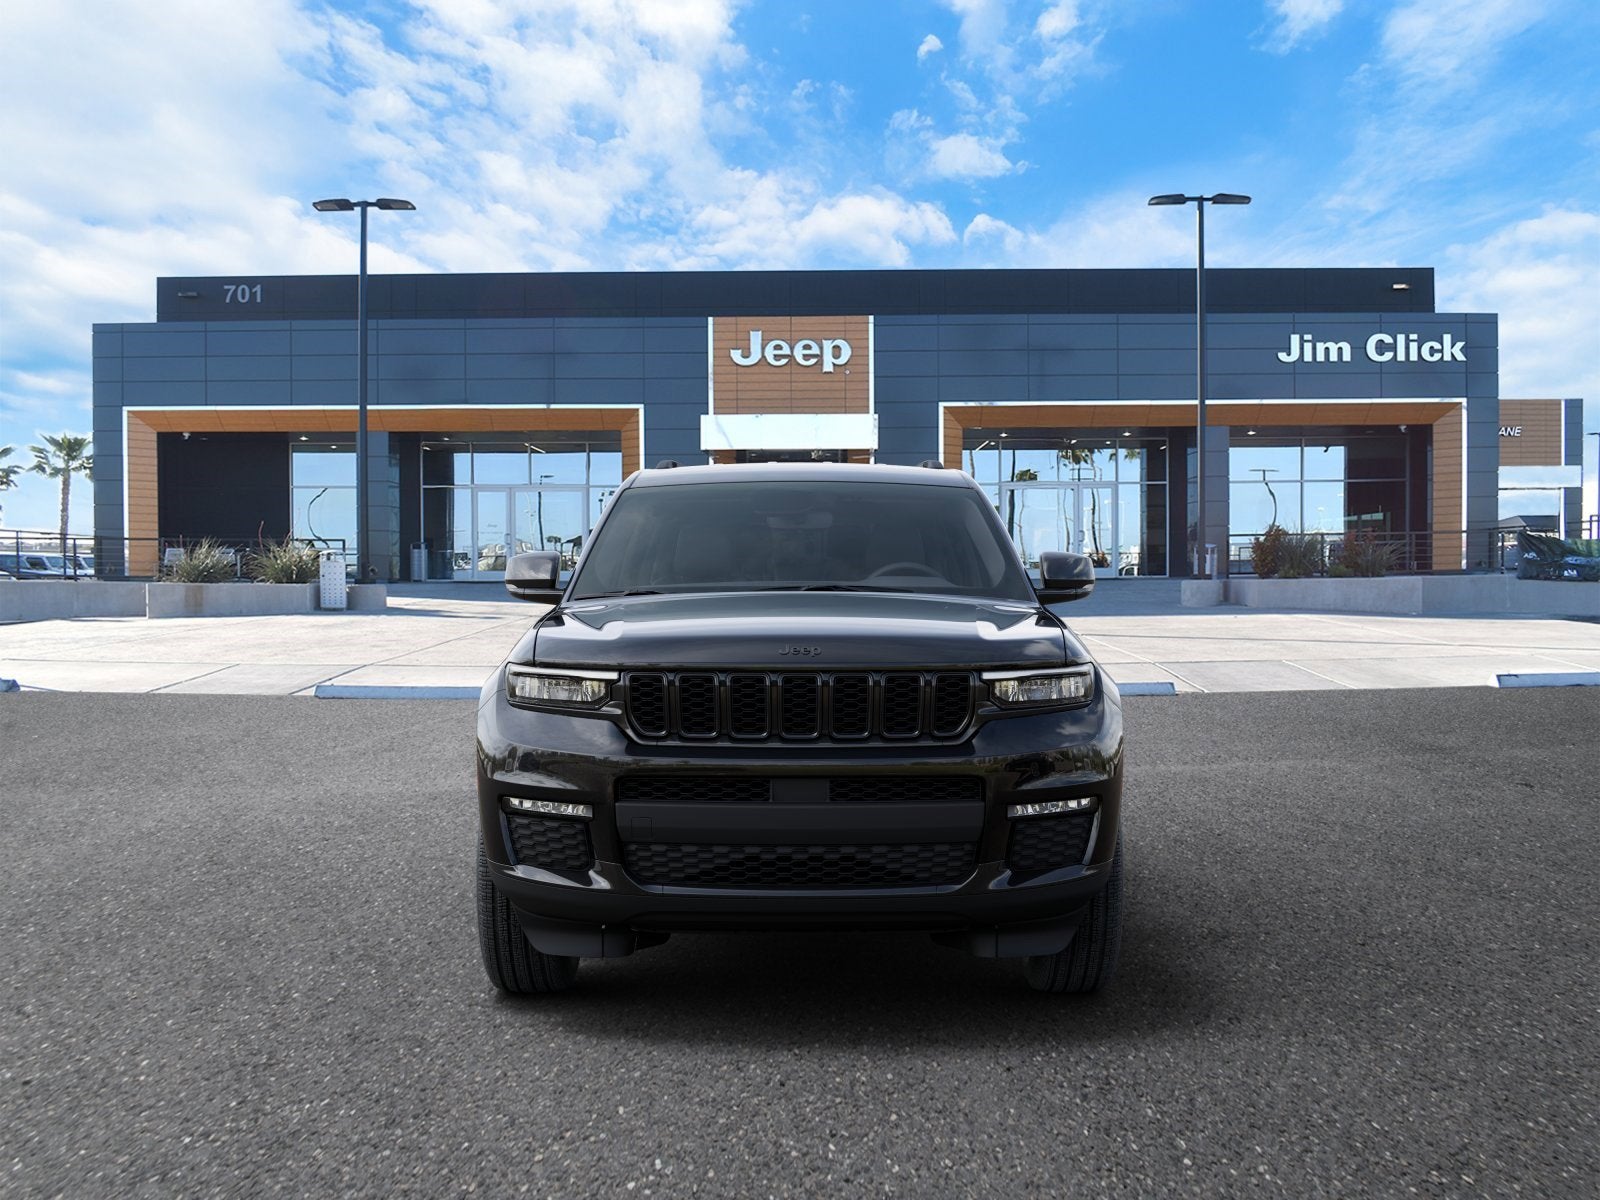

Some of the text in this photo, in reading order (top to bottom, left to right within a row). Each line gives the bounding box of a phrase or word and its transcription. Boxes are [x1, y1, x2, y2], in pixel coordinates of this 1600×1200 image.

[223, 284, 262, 303] 701
[730, 330, 852, 373] Jeep
[1277, 333, 1467, 362] Jim Click
[778, 643, 822, 658] Jeep
